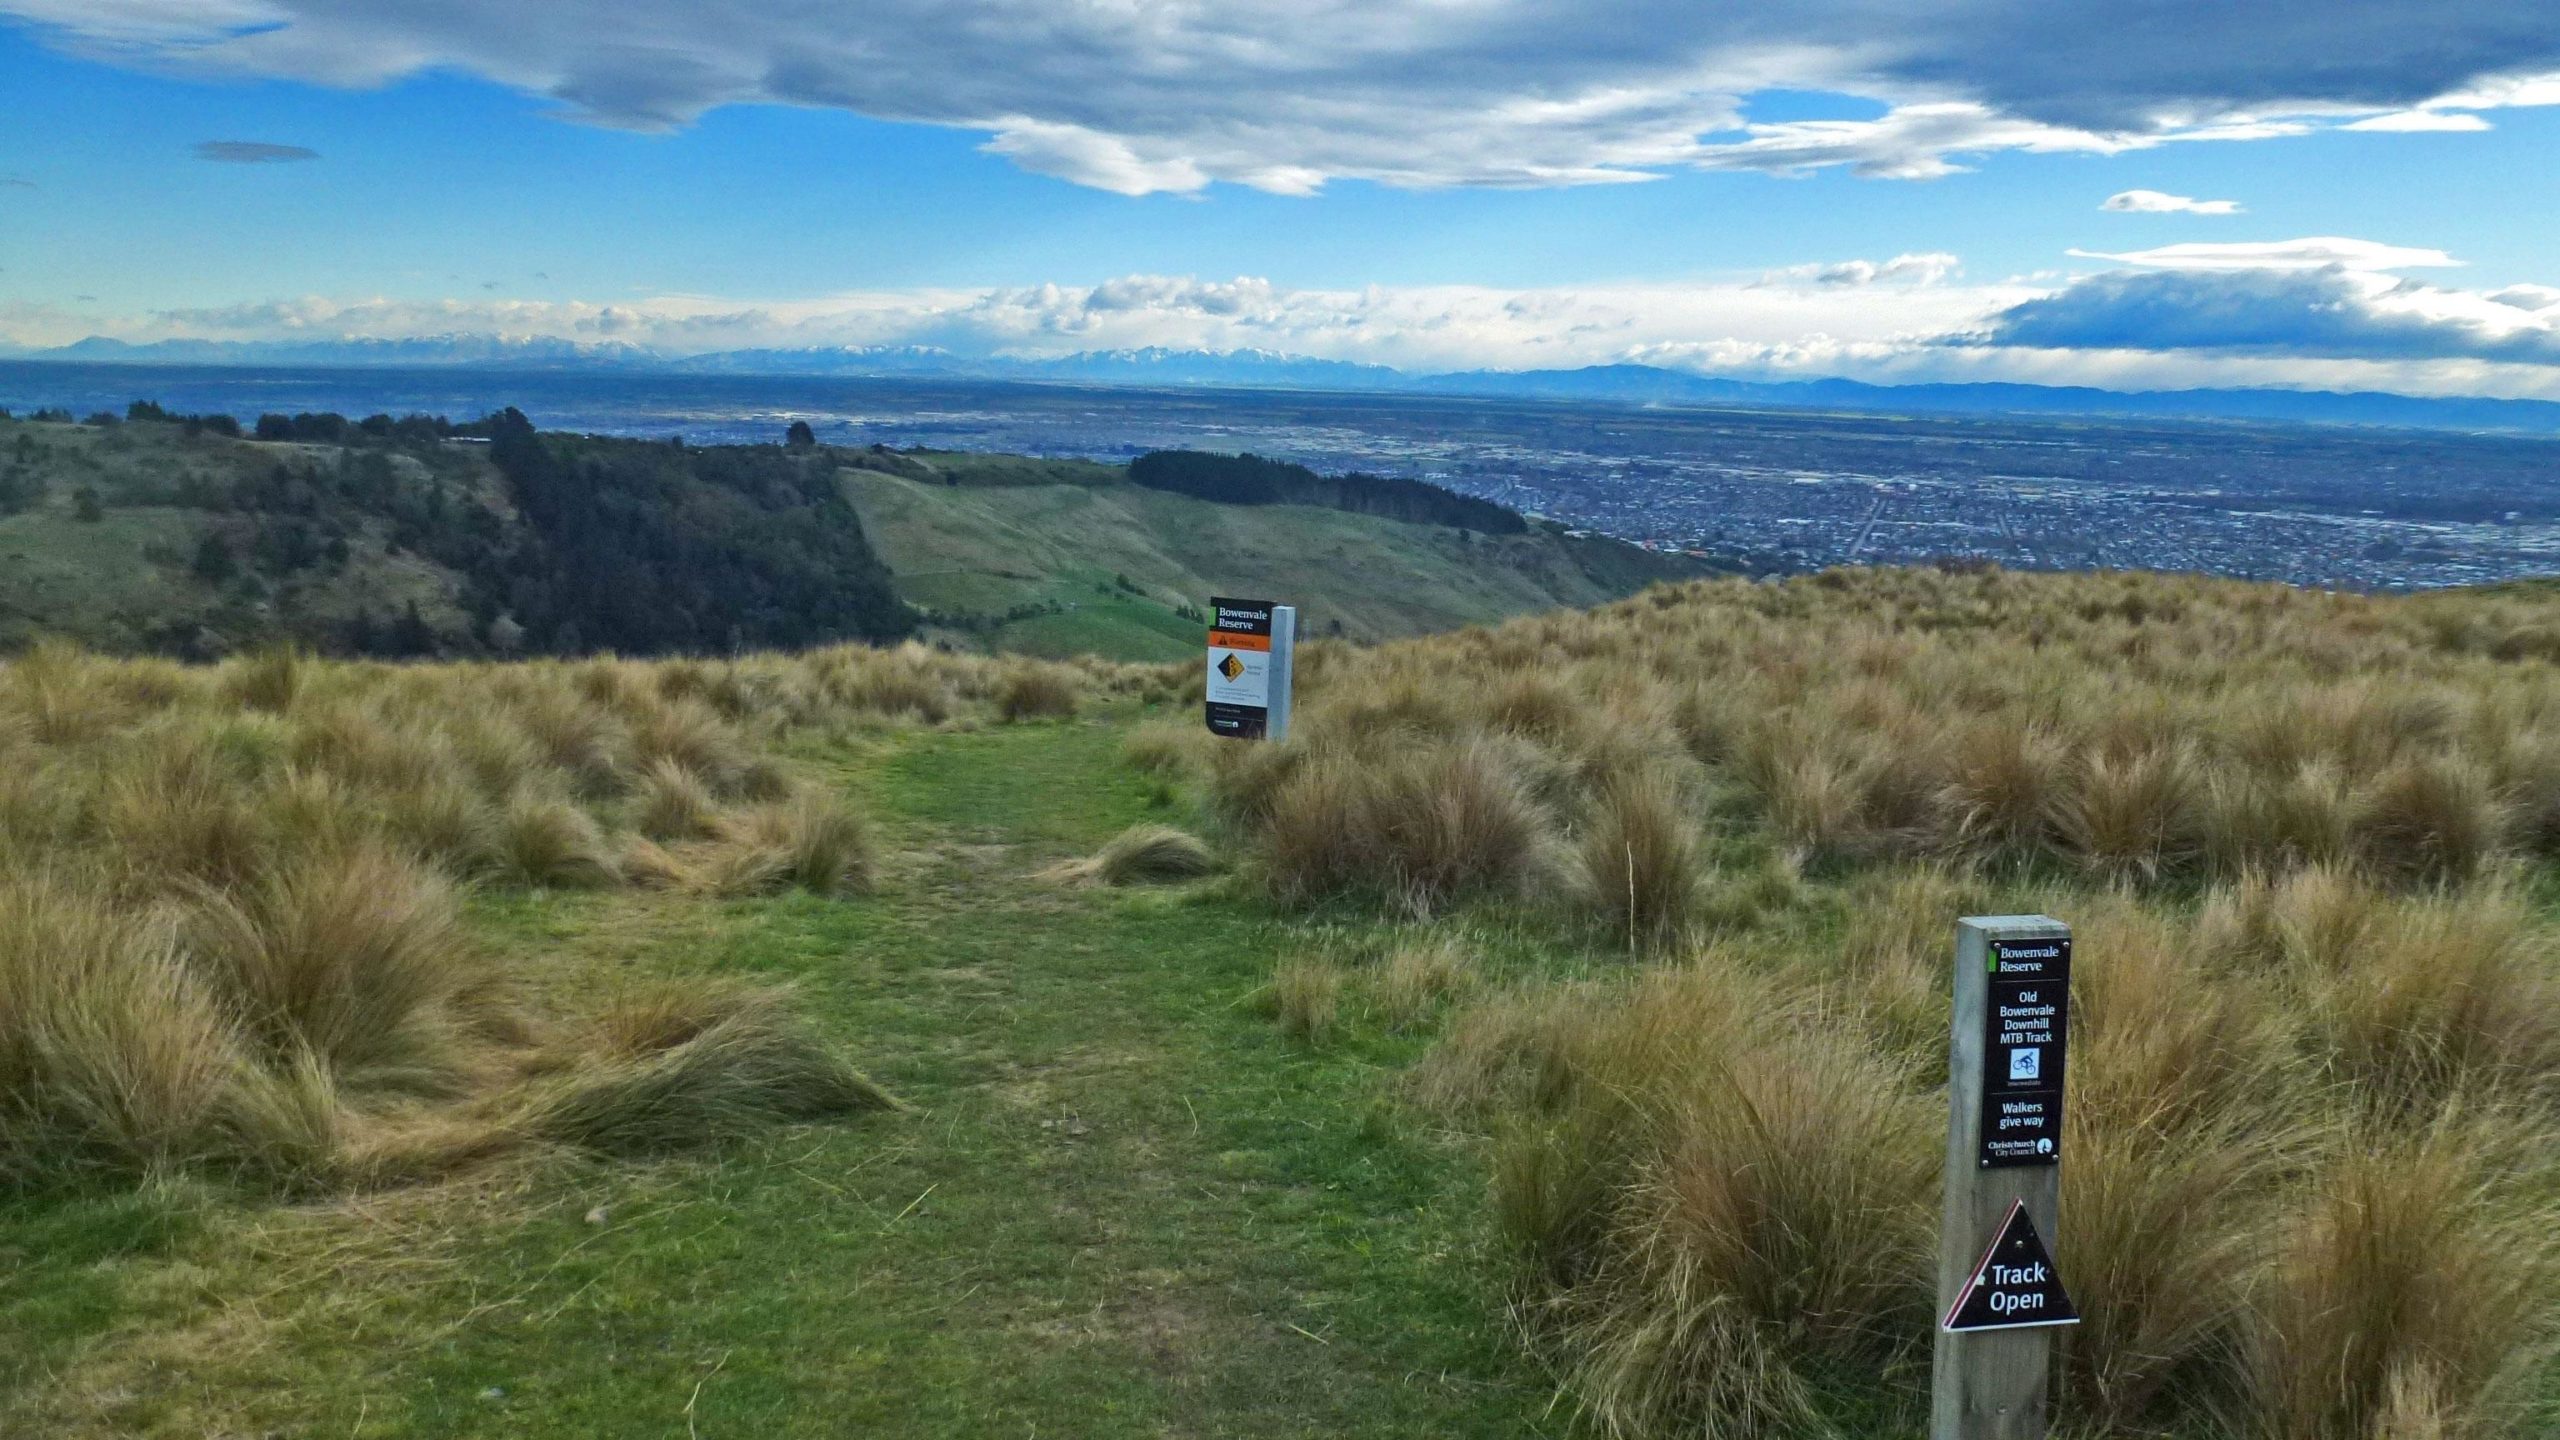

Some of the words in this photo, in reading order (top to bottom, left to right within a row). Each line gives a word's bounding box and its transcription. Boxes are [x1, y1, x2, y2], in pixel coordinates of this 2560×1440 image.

[1219, 607, 1268, 620] Bowenvale
[1218, 618, 1253, 630] Reserve
[2001, 946, 2059, 959] Bowenvale
[2000, 961, 2042, 972] Reserve
[2019, 991, 2037, 1003] Old
[2000, 1004, 2056, 1016] Bowenvale
[2004, 1018, 2050, 1030] Downhill
[2000, 1032, 2023, 1043] MTB
[2026, 1031, 2053, 1043] Track
[2002, 1102, 2043, 1113] Walkers
[1999, 1116, 2022, 1129] give
[2023, 1116, 2044, 1128] way
[1988, 1139, 2036, 1149] Christchurch
[1995, 1149, 2008, 1158] City
[2009, 1147, 2036, 1155] Council
[1992, 1261, 2046, 1285] Track
[1990, 1291, 2044, 1316] Open
